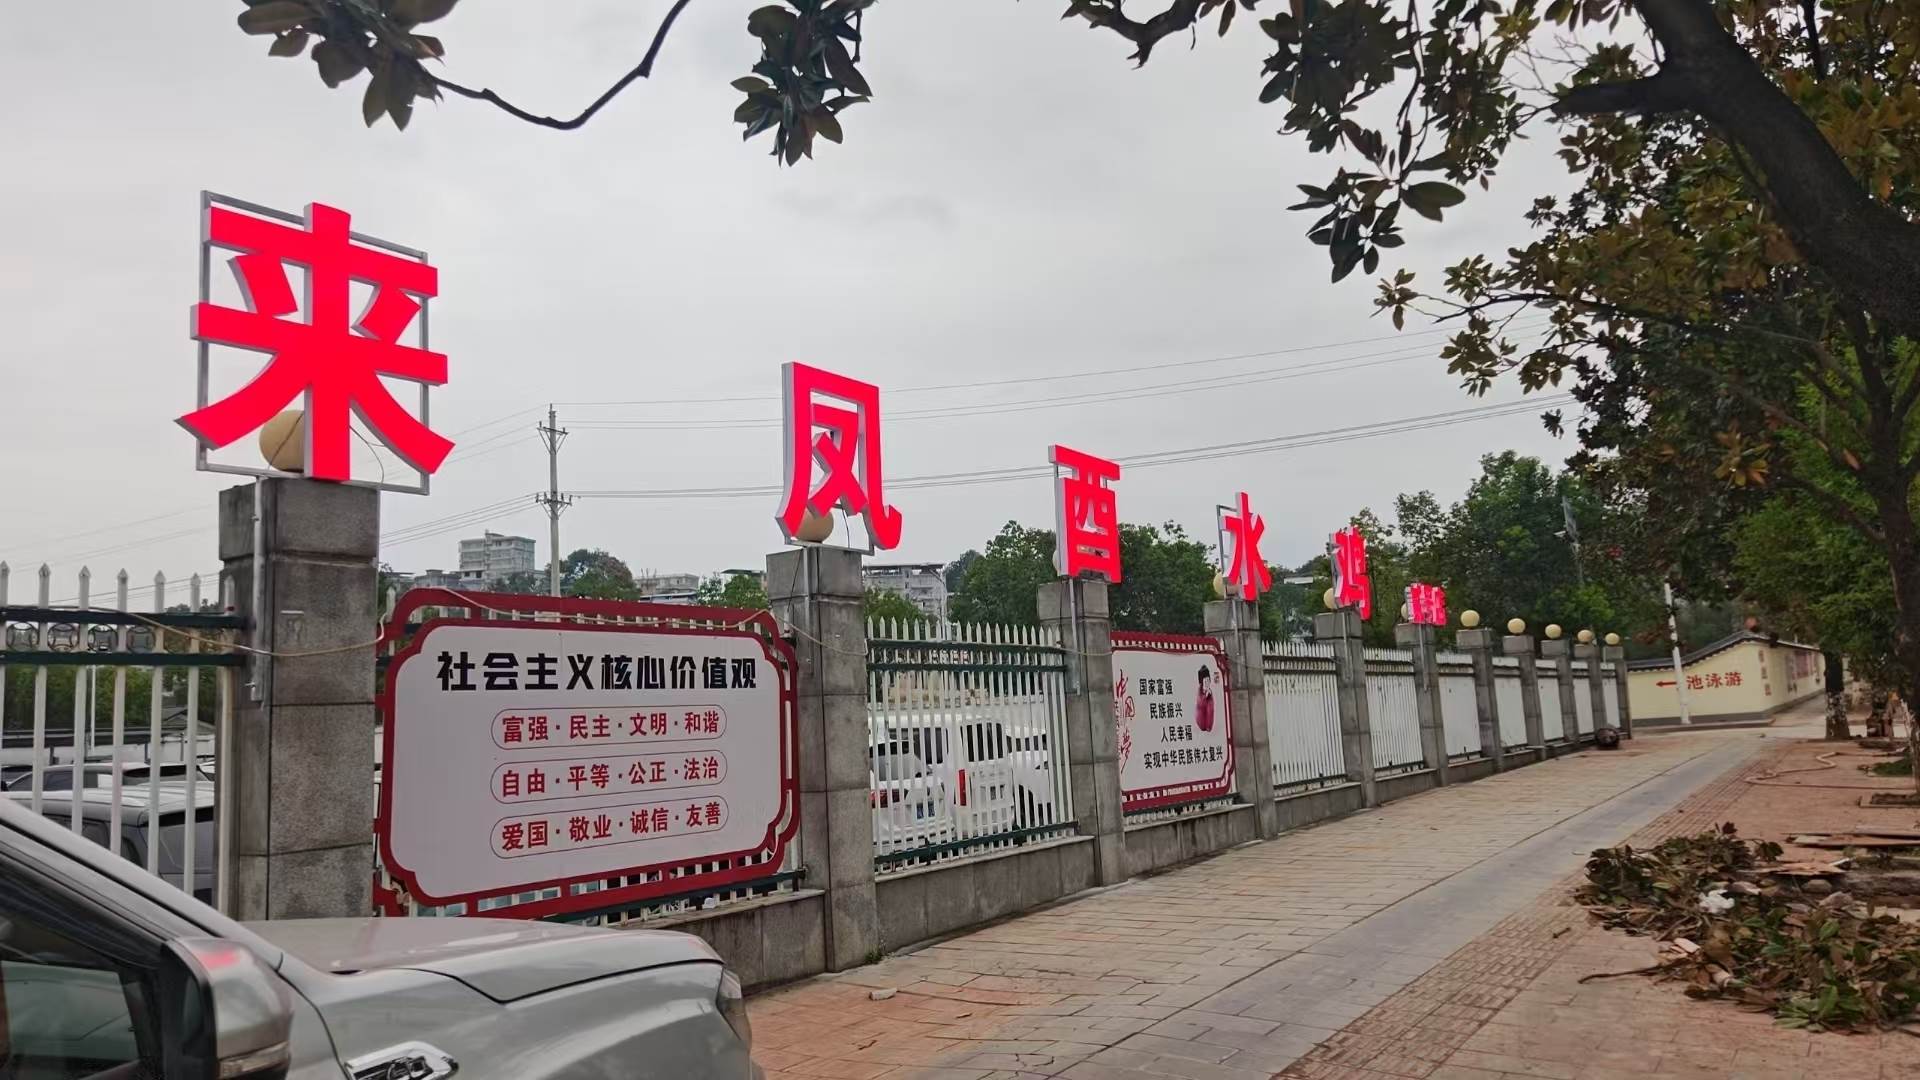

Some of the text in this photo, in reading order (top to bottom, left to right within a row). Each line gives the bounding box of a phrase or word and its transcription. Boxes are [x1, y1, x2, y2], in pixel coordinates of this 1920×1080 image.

[176, 202, 455, 482] 来
[777, 361, 902, 549] 凤
[1049, 444, 1122, 583] 酉
[1222, 492, 1272, 601] 水
[436, 651, 757, 691] 社会主义核心价值观
[1139, 678, 1174, 696] 国家富强
[1149, 703, 1183, 719] 民族振兴
[1160, 725, 1193, 743] 人民幸福
[1143, 746, 1224, 770] 实现中华民族伟大复兴
